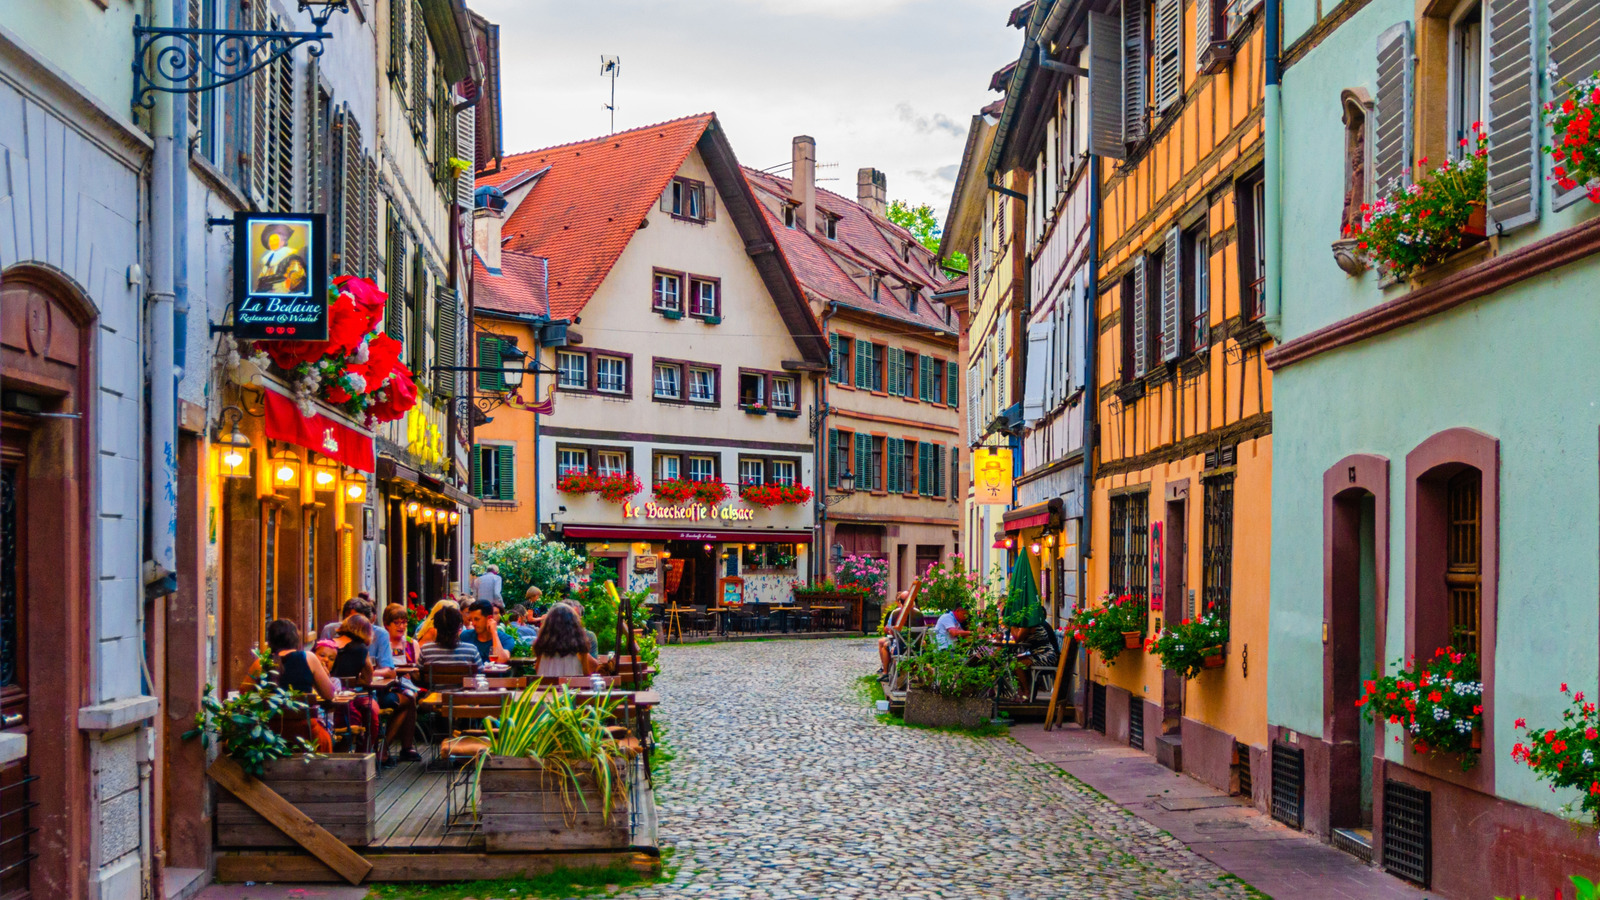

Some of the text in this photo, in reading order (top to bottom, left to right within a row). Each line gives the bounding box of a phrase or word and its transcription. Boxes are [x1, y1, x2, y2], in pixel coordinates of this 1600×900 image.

[239, 296, 322, 313] La Bedaine
[240, 313, 276, 323] Restaurant
[623, 501, 640, 518] Le
[645, 502, 707, 521] Baeckeoffe
